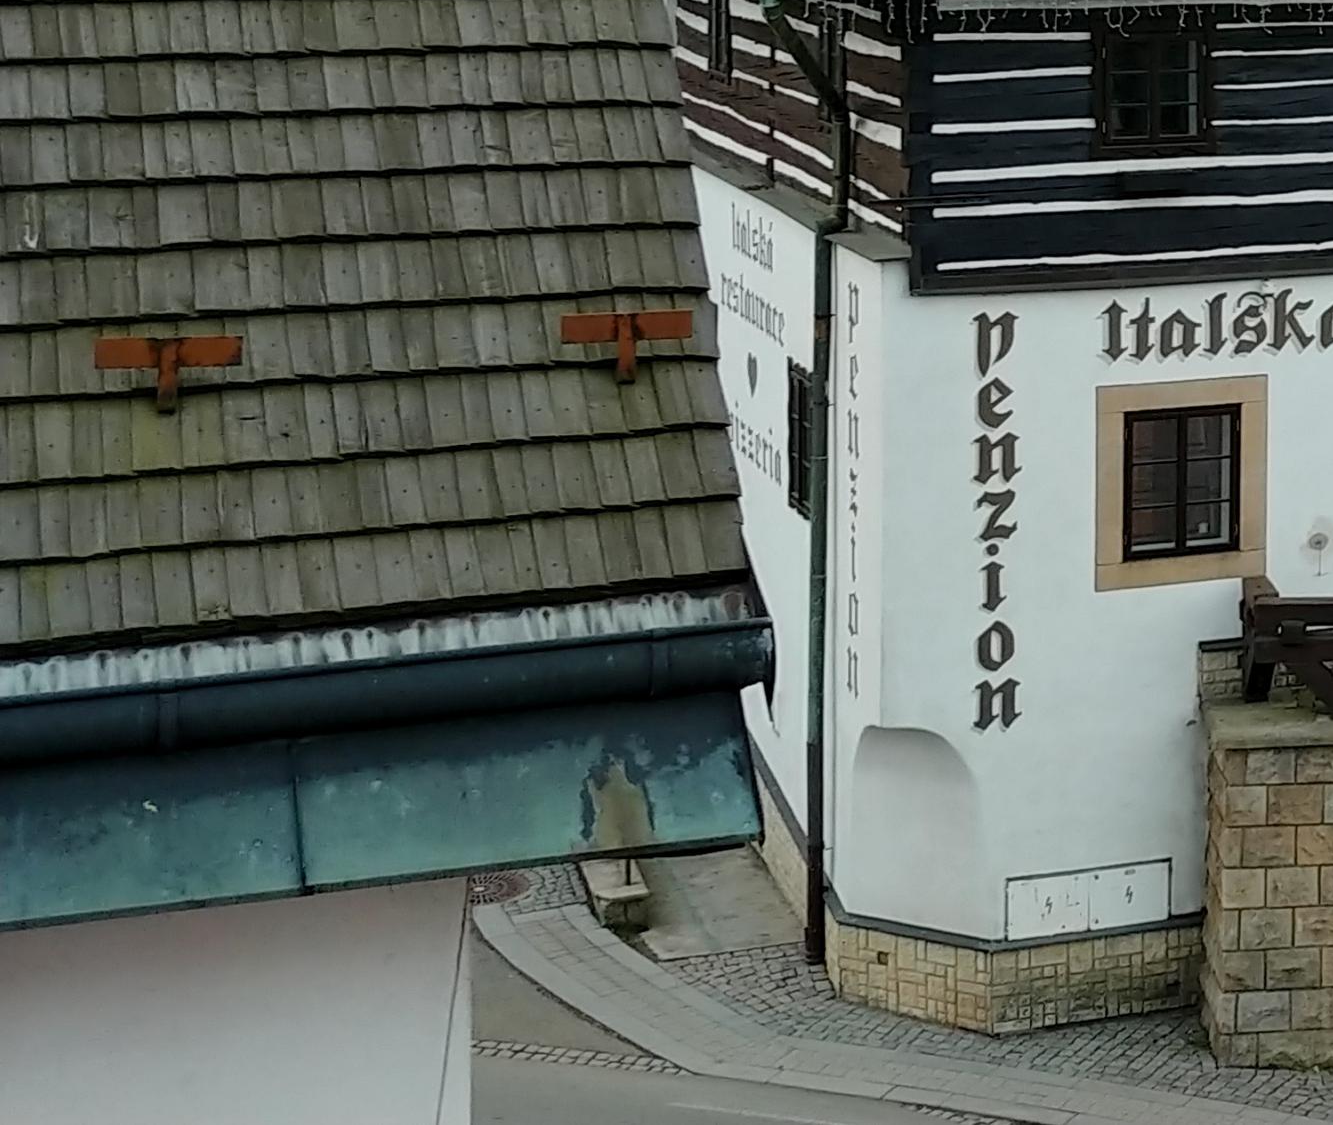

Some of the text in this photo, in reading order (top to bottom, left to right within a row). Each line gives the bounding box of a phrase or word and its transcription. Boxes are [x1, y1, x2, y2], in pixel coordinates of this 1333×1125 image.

[731, 200, 774, 273] Italská
[720, 272, 786, 348] restaurace
[729, 400, 782, 488] izzeria
[971, 310, 1023, 734] penzion
